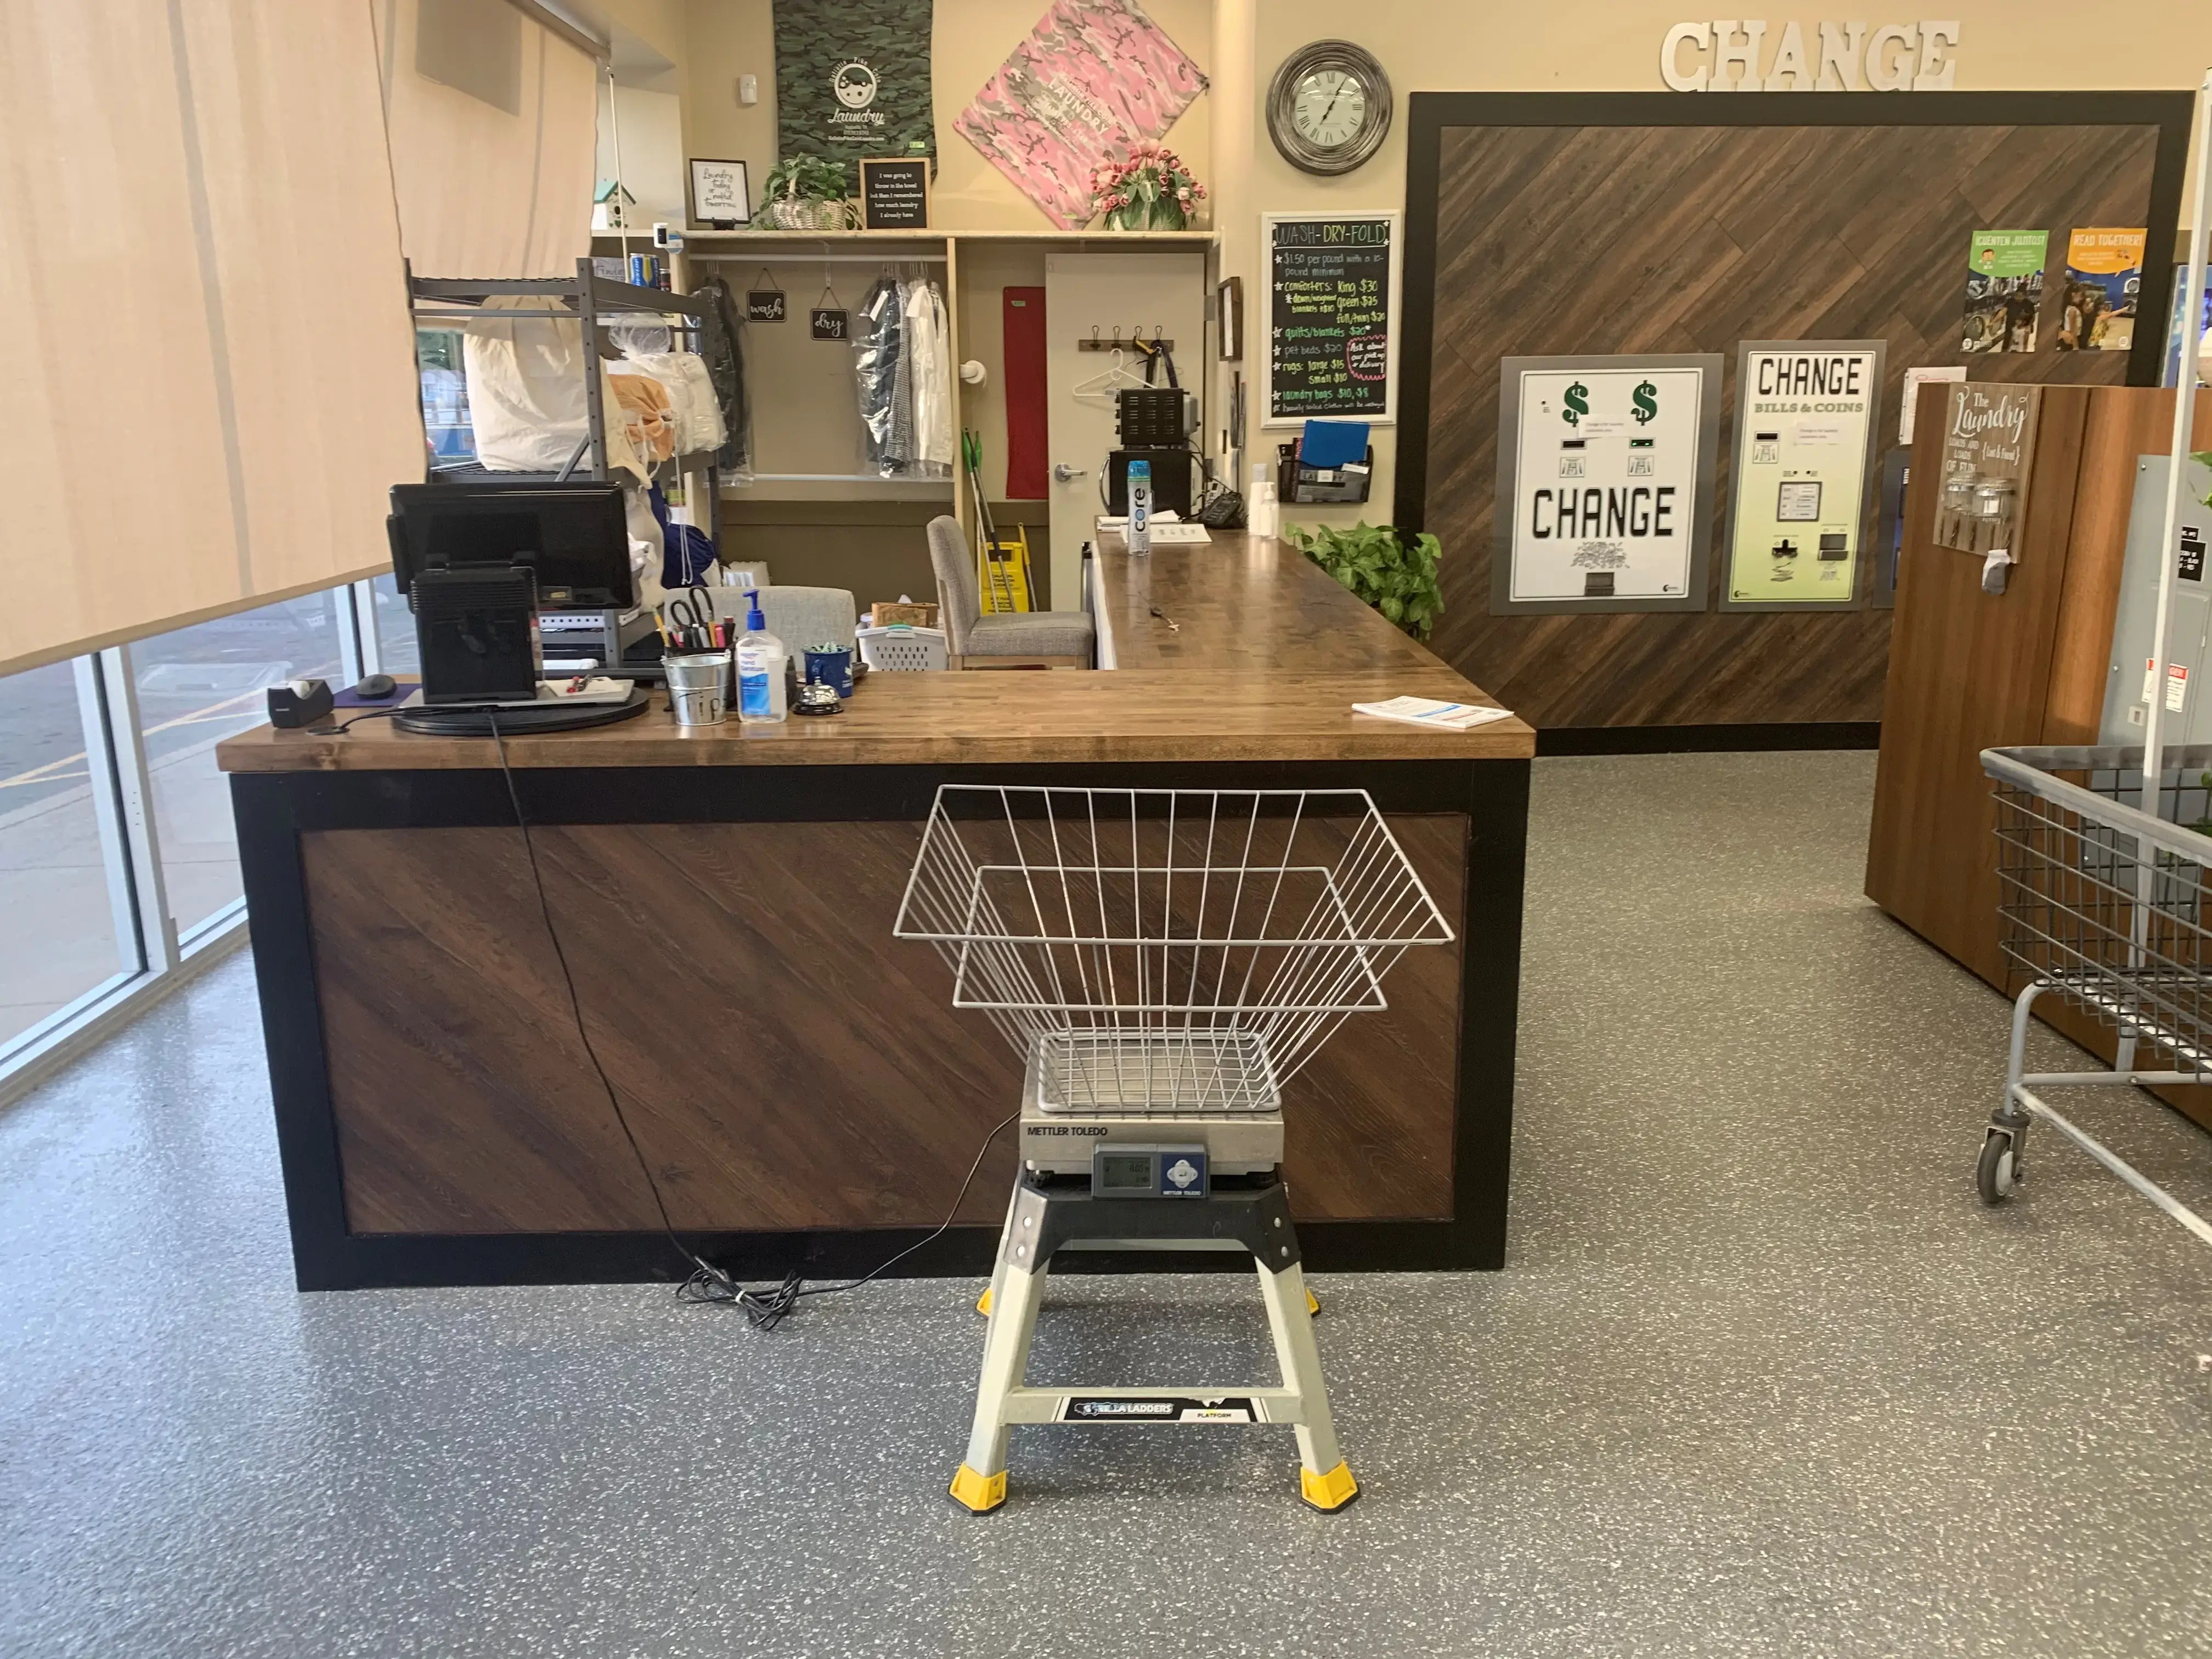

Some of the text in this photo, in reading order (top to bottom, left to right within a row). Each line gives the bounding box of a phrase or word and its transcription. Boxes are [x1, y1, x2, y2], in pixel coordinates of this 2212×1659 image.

[1660, 20, 1961, 92] CHANGE
[1048, 78, 1109, 136] LAUNDRY
[827, 108, 885, 126] Laundry
[2074, 234, 2143, 246] READ TOGETHER!
[1283, 252, 1305, 266] $1.50
[1307, 255, 1320, 267] per
[1322, 253, 1344, 267] pound
[1346, 253, 1362, 263] with
[1285, 267, 1308, 278] pound
[1359, 278, 1378, 294] $30
[750, 298, 784, 319] wash
[815, 312, 843, 337] dry
[1284, 342, 1342, 359] pet beds $20
[1350, 342, 1364, 352] Ask
[1308, 360, 1328, 375] large
[1330, 359, 1345, 370] $15
[1333, 372, 1348, 383] $10
[1759, 358, 1863, 396] CHANGE
[1283, 390, 1313, 402] laundry
[1314, 390, 1333, 403] bags
[1974, 392, 1990, 408] The
[1754, 403, 1863, 413] BILLS & COINS
[1951, 386, 2030, 444] Laundry
[1946, 459, 1957, 472] OF
[1134, 488, 1146, 532] core
[1532, 486, 1676, 539] CHANGE
[1027, 1126, 1108, 1136] METTLER TOLEDO
[1127, 1403, 1173, 1413] LADDERS
